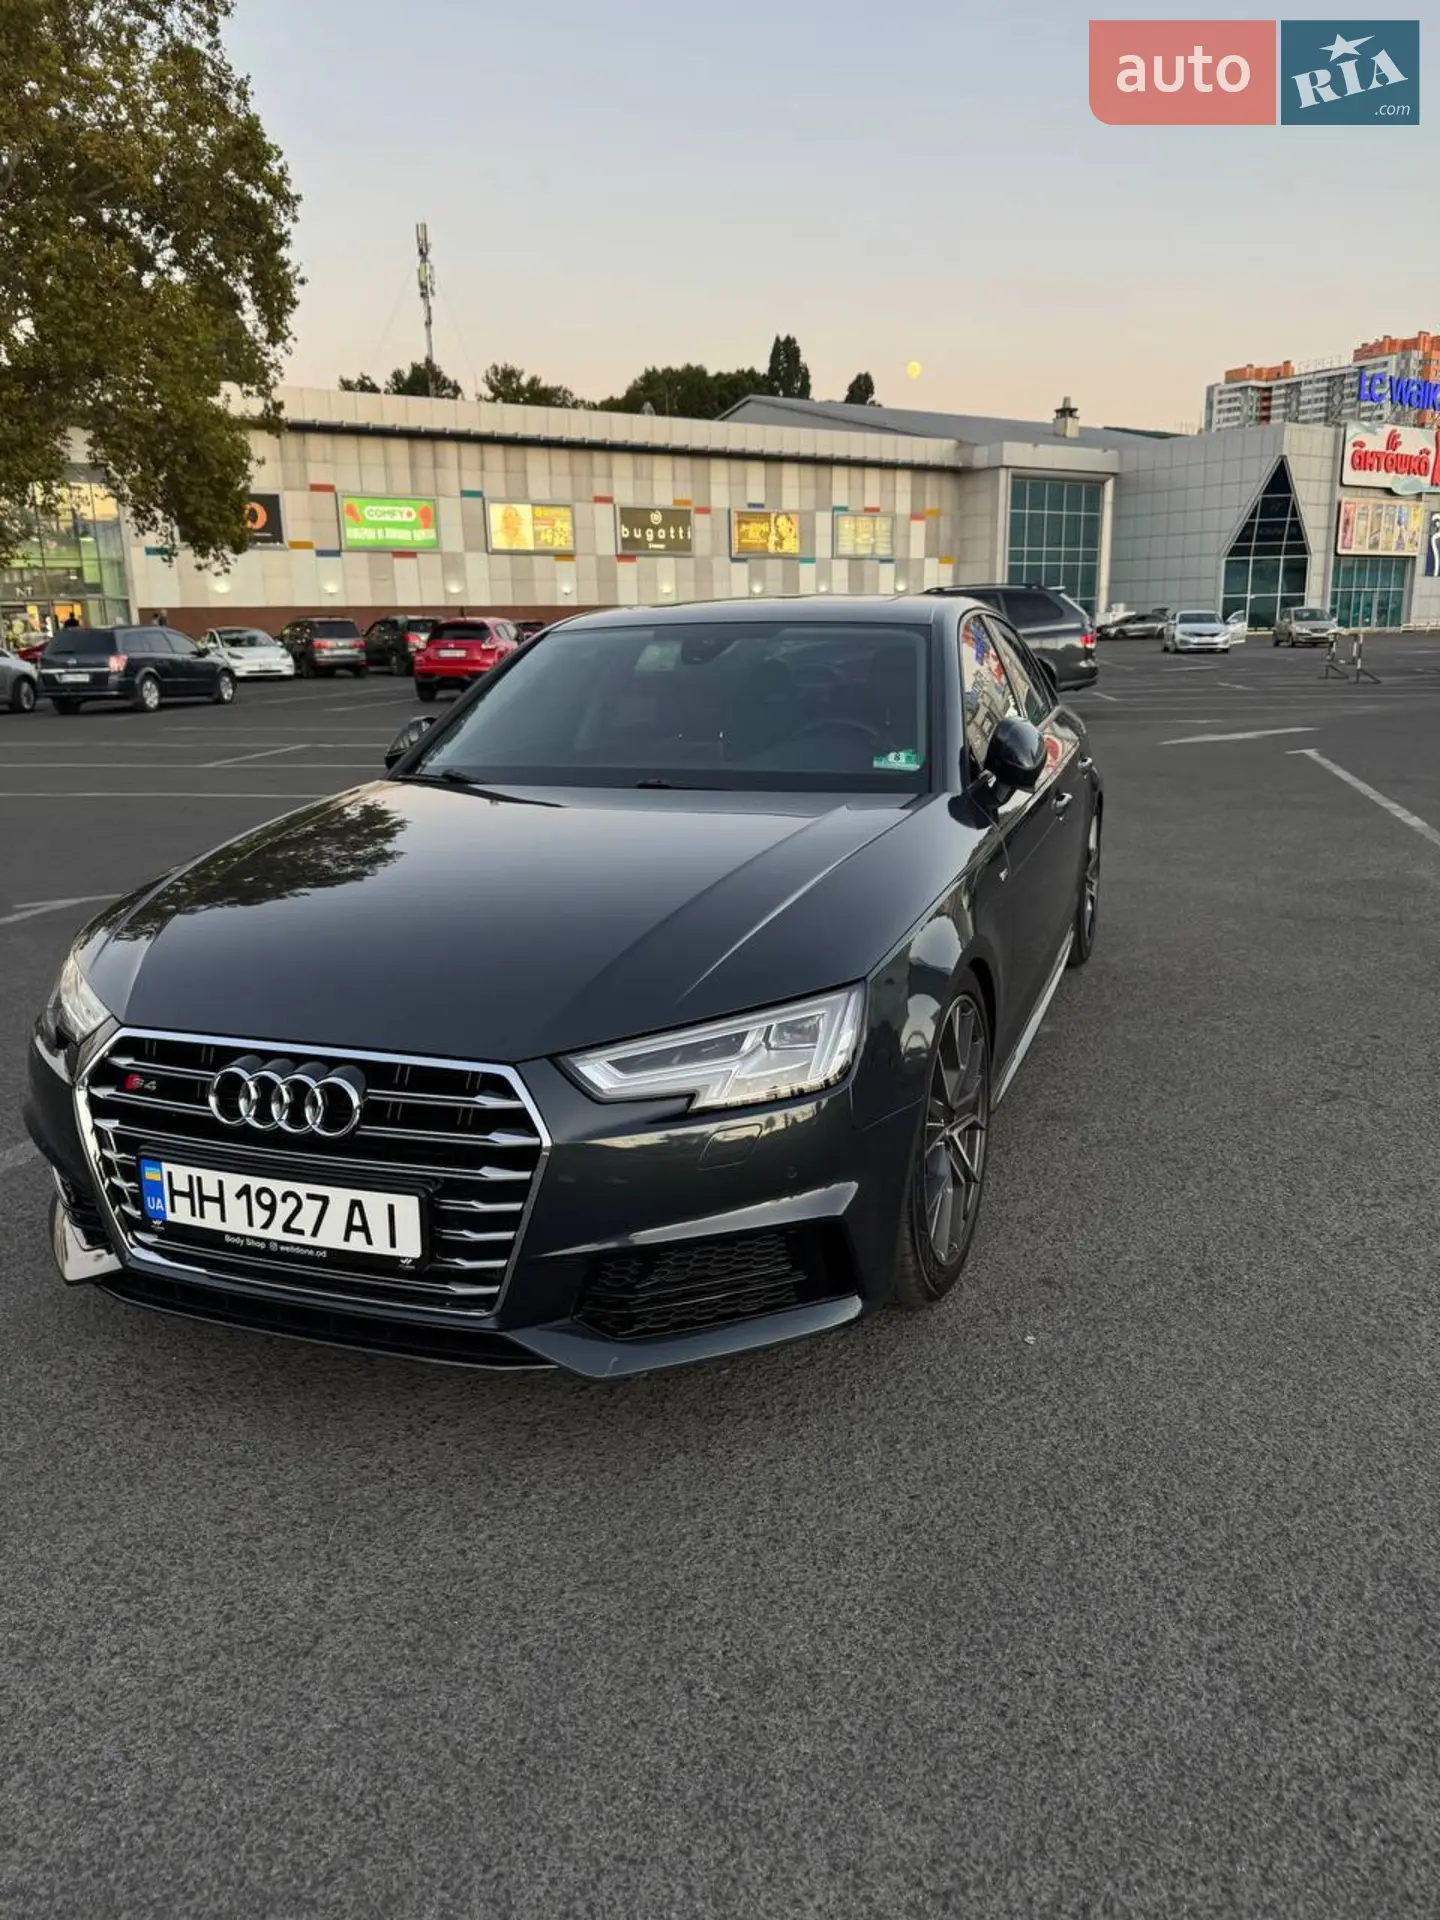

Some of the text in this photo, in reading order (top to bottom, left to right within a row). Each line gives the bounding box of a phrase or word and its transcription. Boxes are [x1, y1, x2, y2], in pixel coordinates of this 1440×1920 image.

[1359, 371, 1386, 404] LC
[366, 507, 405, 519] COMFY
[621, 524, 691, 542] bugatti
[147, 1195, 165, 1211] UA
[166, 1170, 397, 1249] HH 1927 AI
[224, 1234, 244, 1247] Body
[245, 1237, 266, 1249] Shop
